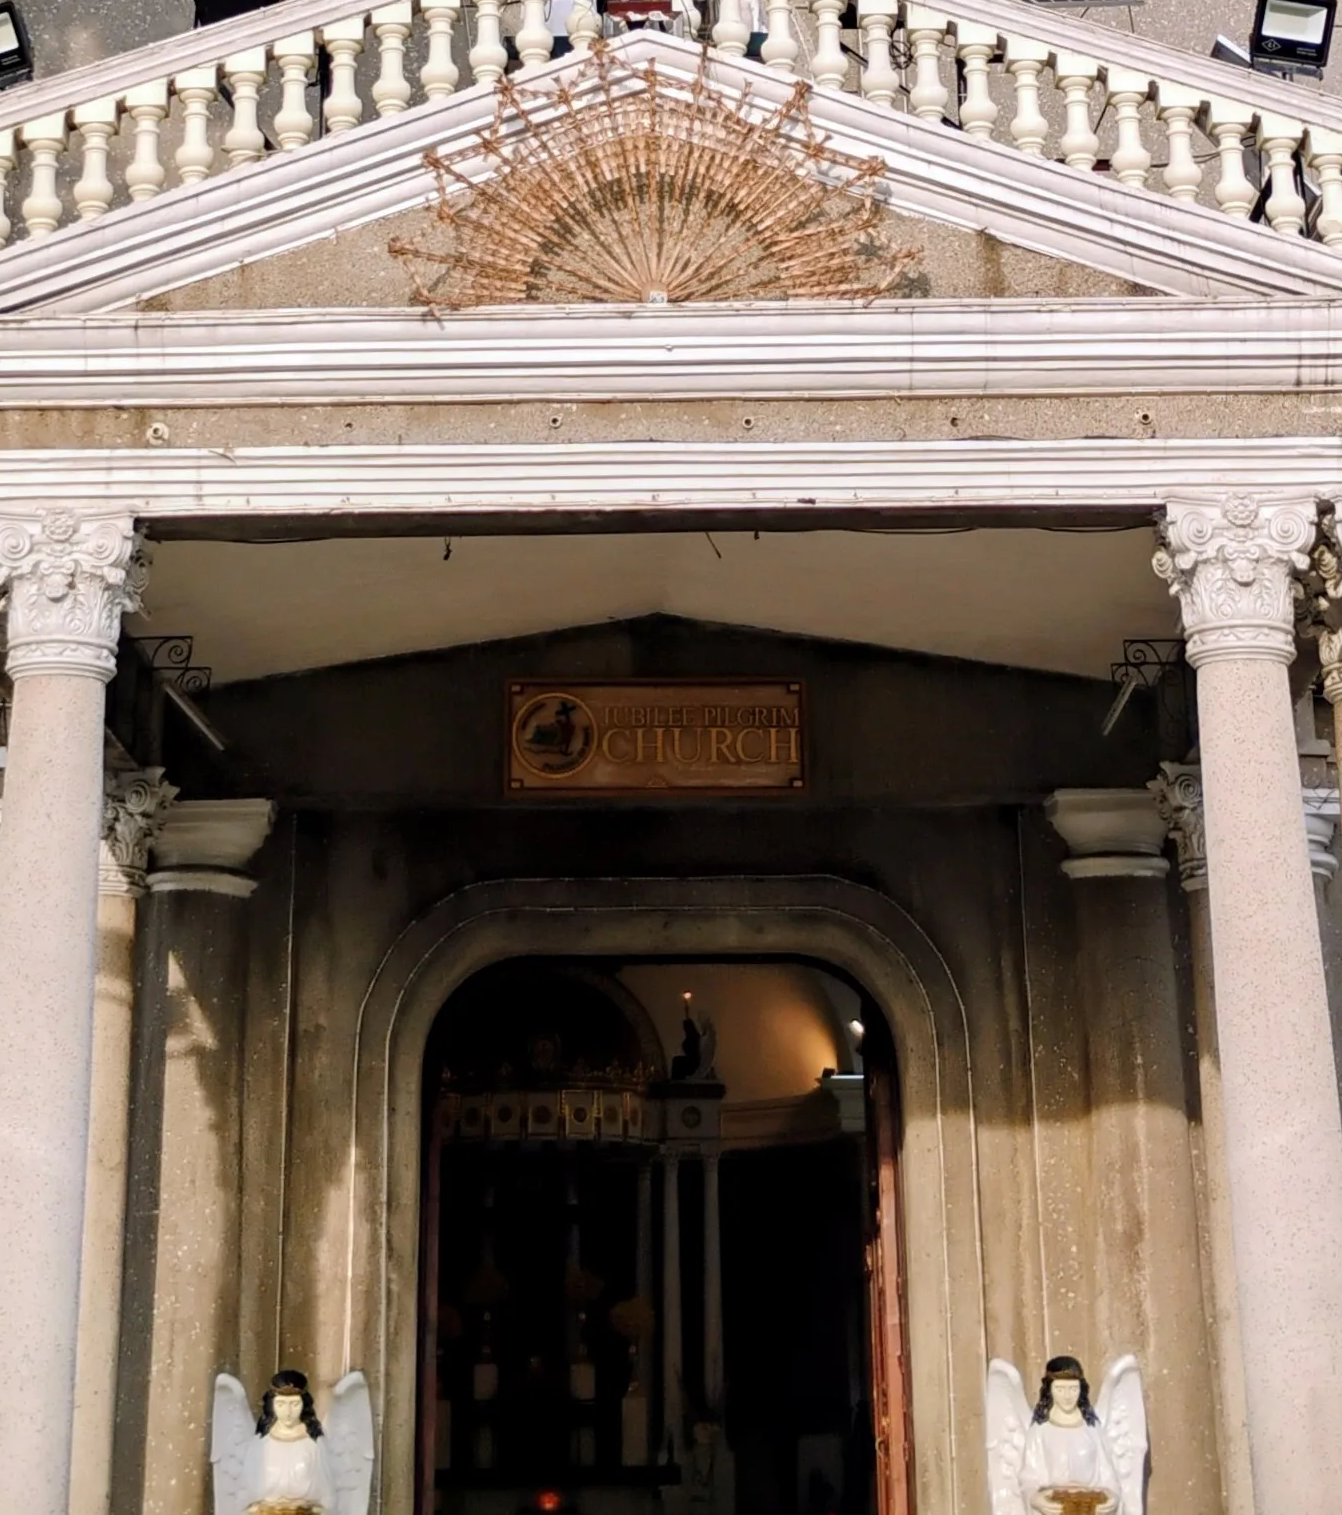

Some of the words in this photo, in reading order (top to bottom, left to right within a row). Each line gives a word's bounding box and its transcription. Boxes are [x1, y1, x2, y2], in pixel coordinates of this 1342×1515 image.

[601, 707, 695, 726] JUBILEE
[704, 707, 800, 726] PILGRIM
[601, 726, 800, 764] CHURCH
